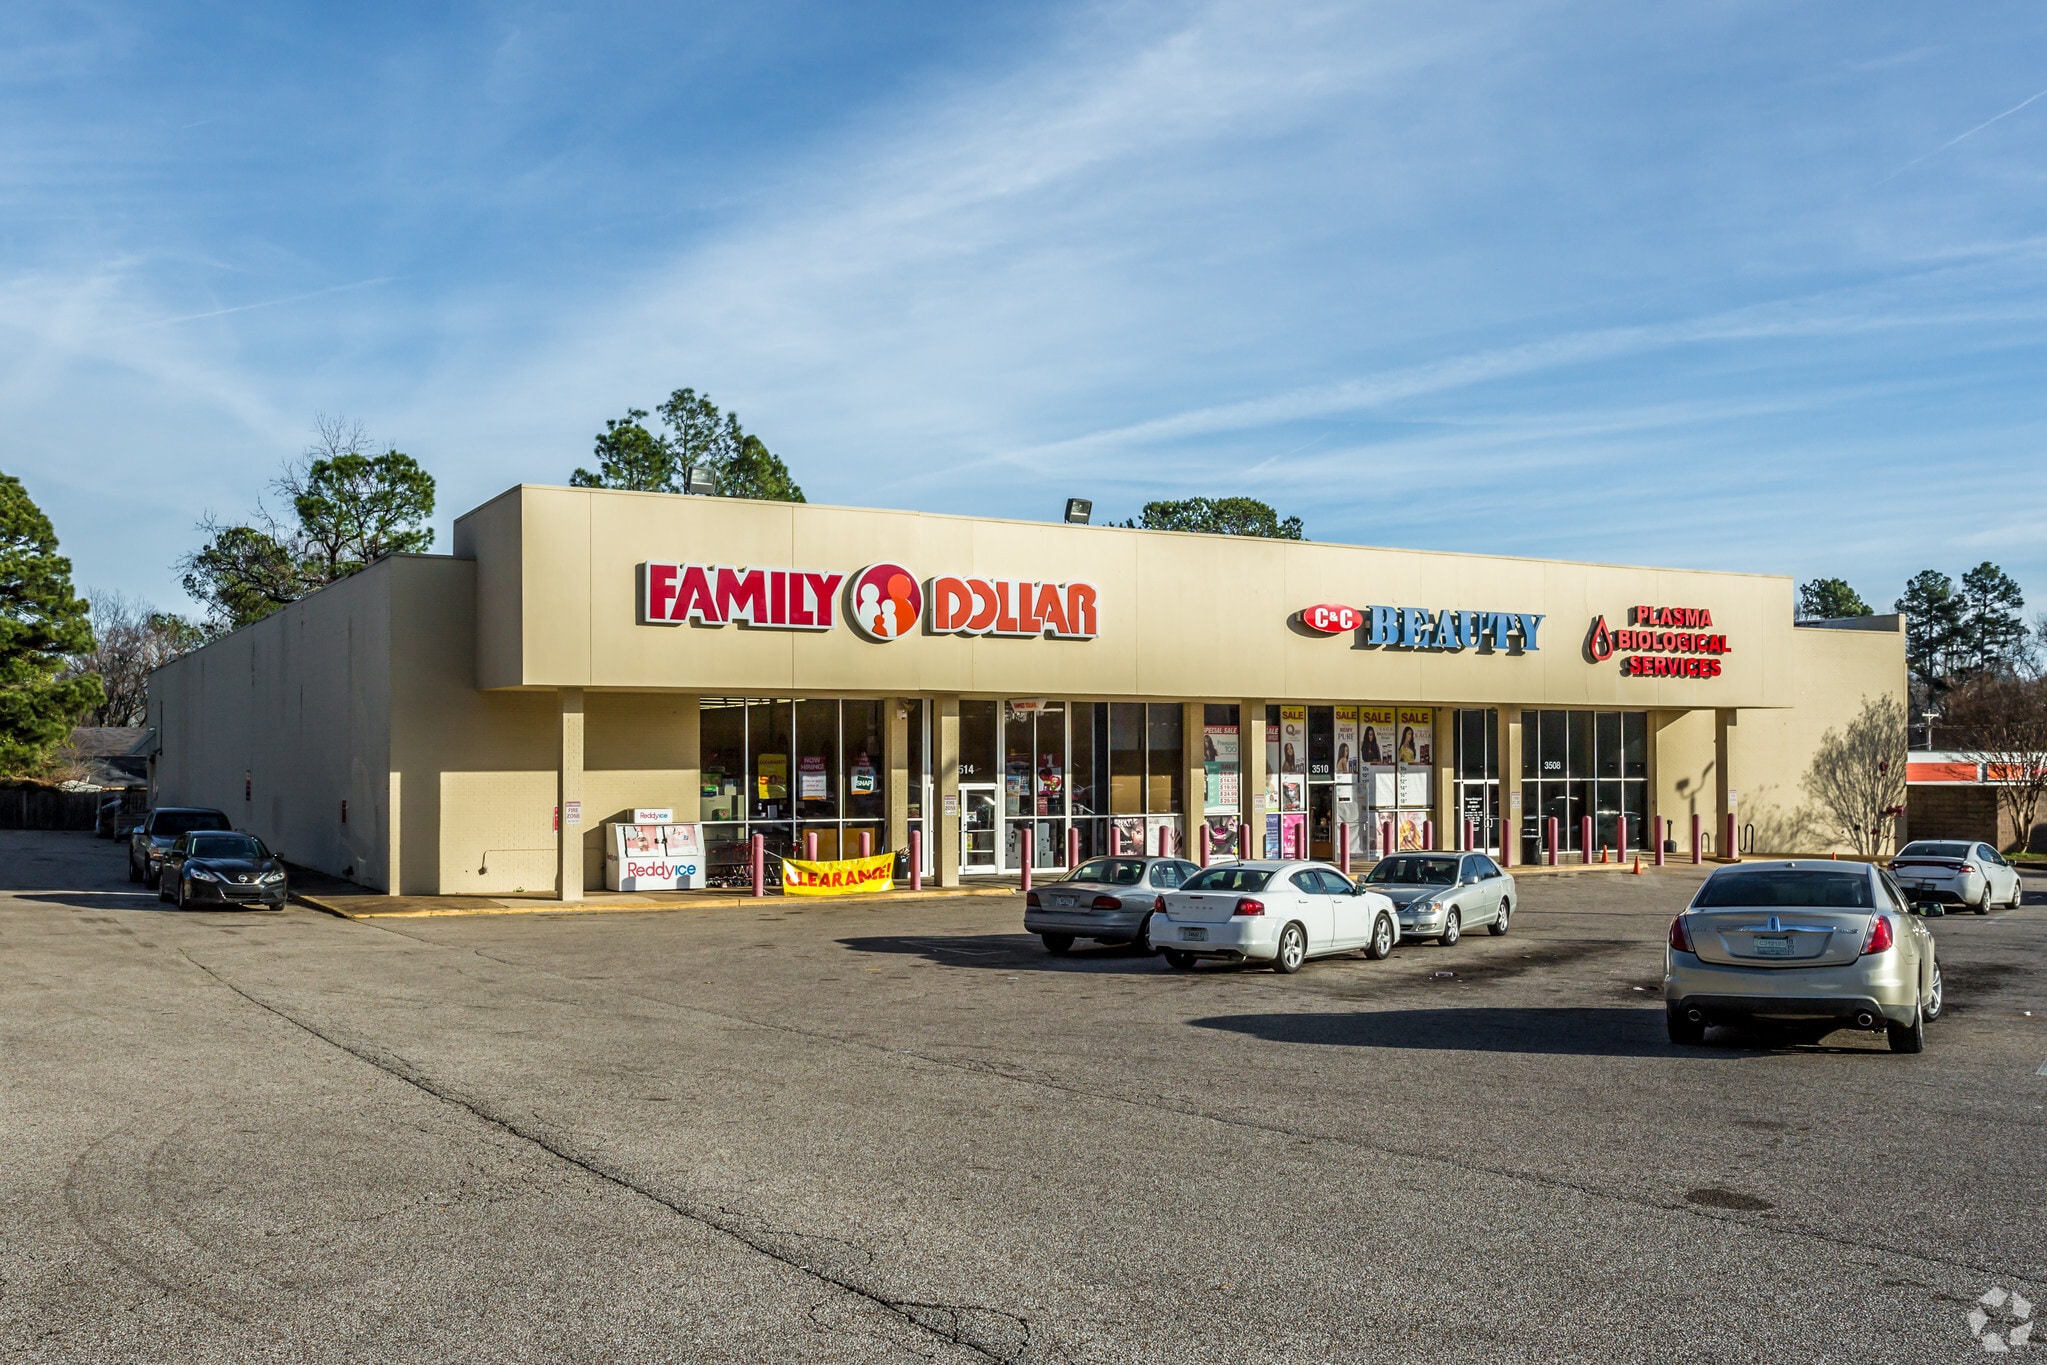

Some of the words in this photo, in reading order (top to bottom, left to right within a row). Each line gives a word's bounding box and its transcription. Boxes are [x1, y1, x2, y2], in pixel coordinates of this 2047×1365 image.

[646, 561, 849, 630] FAMILY
[930, 575, 1099, 639] DOLLAR
[1313, 607, 1354, 630] C&C
[1635, 605, 1713, 627] PLASMA
[1366, 605, 1546, 651] BEAUTY
[1617, 629, 1732, 652] BIOLOGICAL
[1628, 655, 1722, 677] SERVICES
[1281, 711, 1304, 720] SALE
[1335, 711, 1357, 720] SALE
[1363, 712, 1392, 723] SALE
[1401, 712, 1429, 724] SALE
[1311, 764, 1330, 774] 3510
[1544, 761, 1561, 770] 3508
[785, 862, 892, 888] CLEARANCE!
